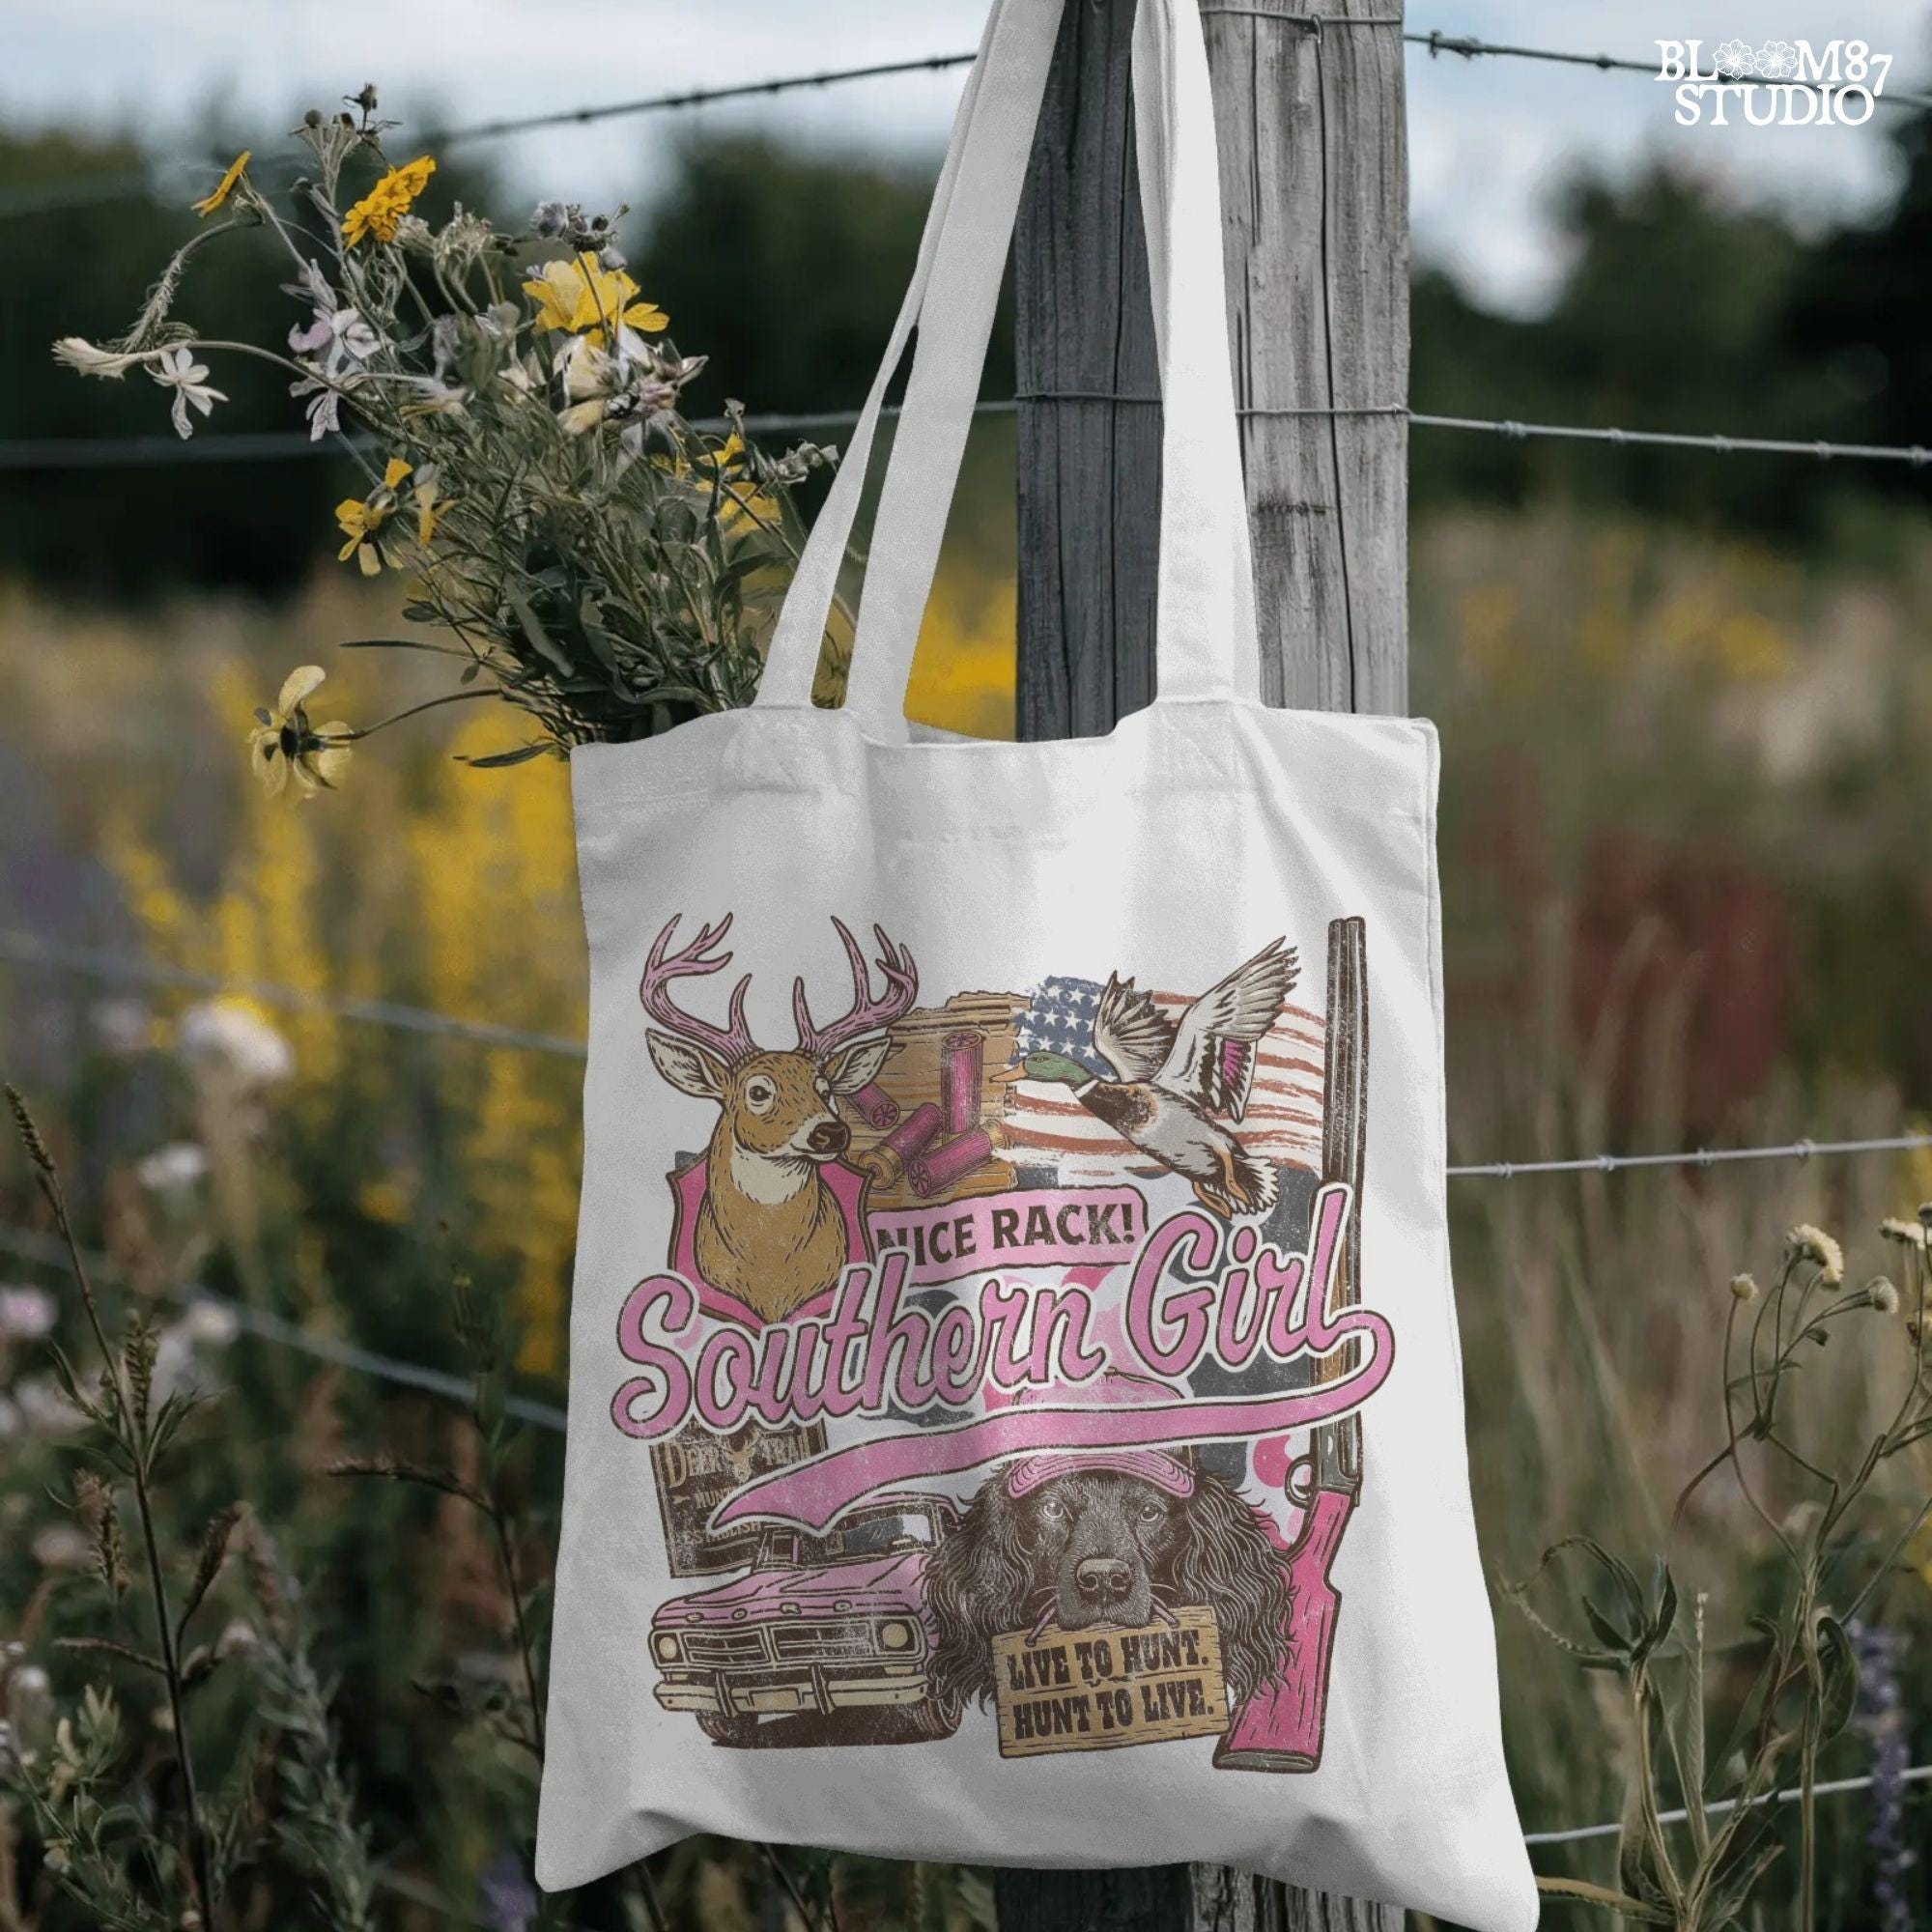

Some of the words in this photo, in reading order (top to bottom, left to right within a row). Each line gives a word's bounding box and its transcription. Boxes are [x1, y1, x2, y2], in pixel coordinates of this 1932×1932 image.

[991, 1203, 1135, 1249] RACK!
[610, 1250, 1106, 1440] Southern
[1125, 1187, 1348, 1377] Girl
[1007, 1646, 1070, 1690] LIVE
[1074, 1638, 1113, 1680] TO
[1120, 1630, 1209, 1673] HUNT.
[1012, 1693, 1091, 1739] HUNT
[1095, 1688, 1134, 1729] TO
[1140, 1678, 1214, 1722] LIVE.
